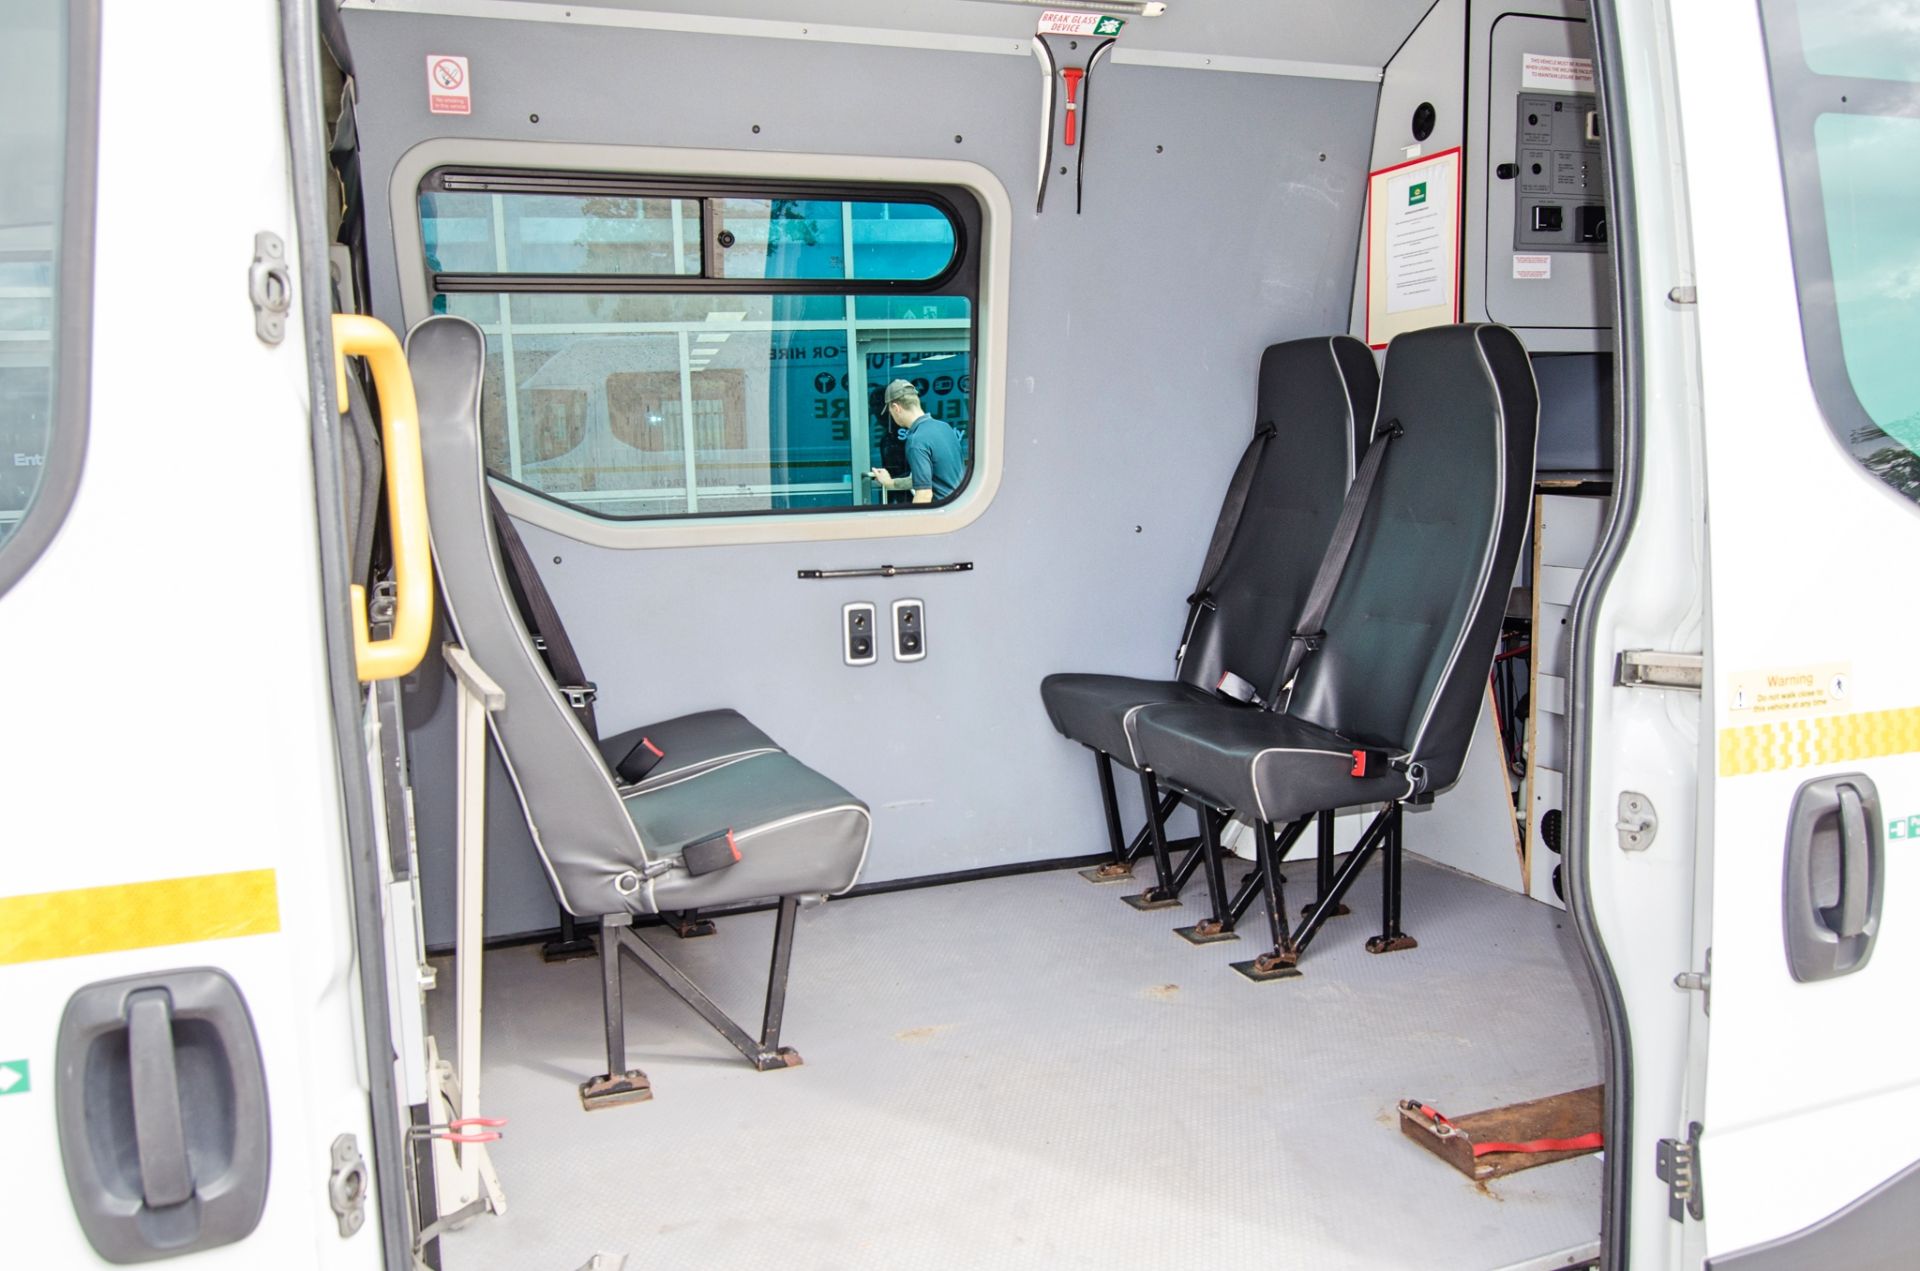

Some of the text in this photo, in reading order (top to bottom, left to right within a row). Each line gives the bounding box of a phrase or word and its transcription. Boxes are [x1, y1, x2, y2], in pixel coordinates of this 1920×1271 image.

[1042, 13, 1097, 25] BREAK GLASS
[1050, 23, 1080, 32] DEVICE
[1767, 674, 1814, 687] Warning
[1781, 691, 1796, 699] walk
[1798, 689, 1815, 697] close
[1767, 702, 1790, 711] vehicle
